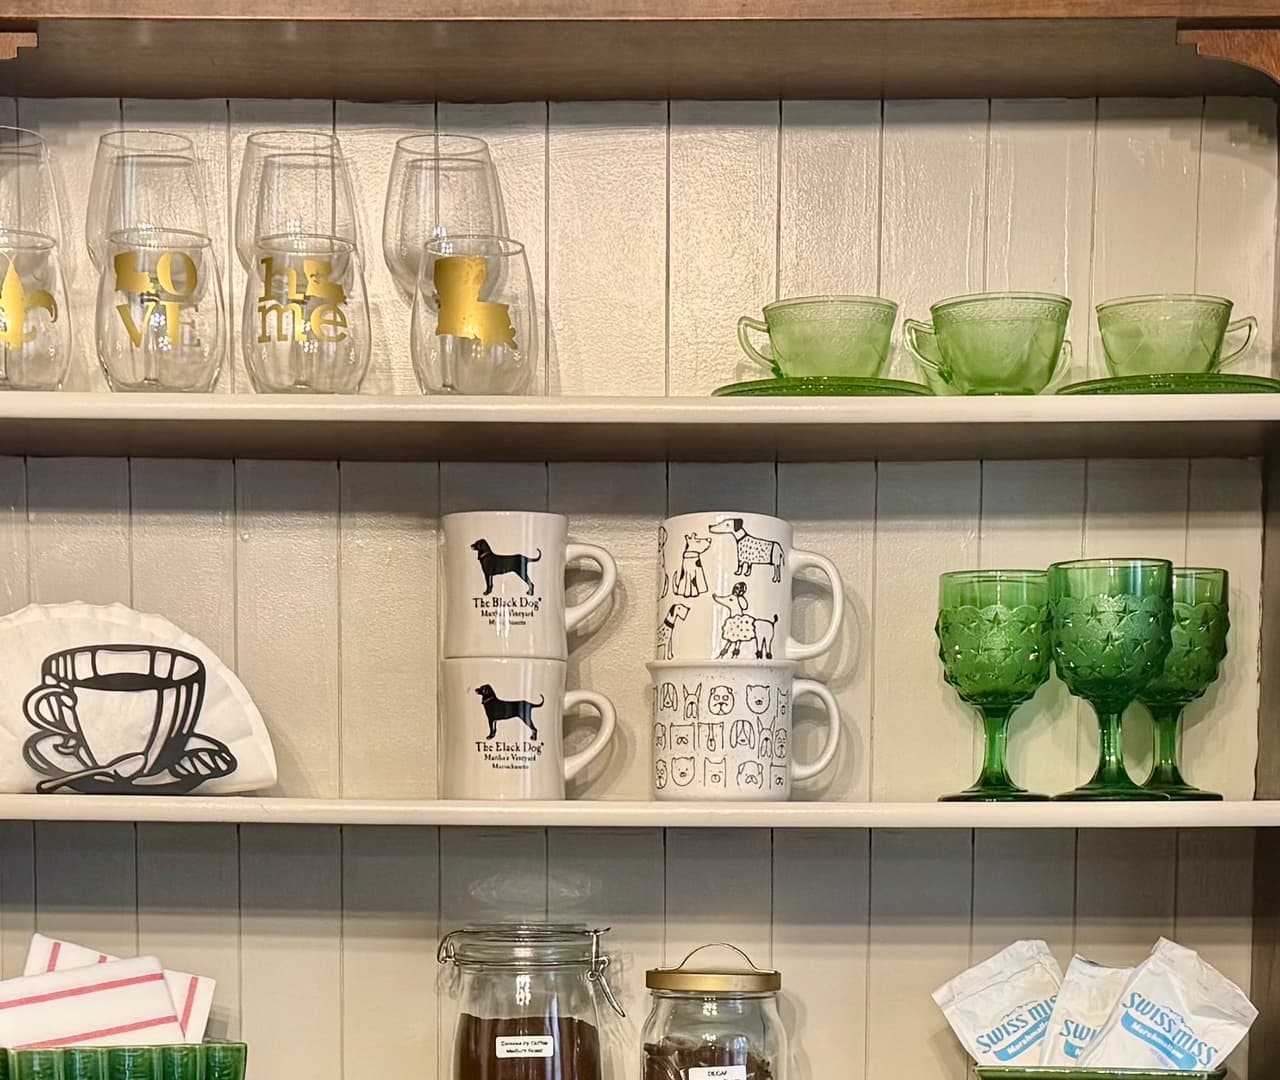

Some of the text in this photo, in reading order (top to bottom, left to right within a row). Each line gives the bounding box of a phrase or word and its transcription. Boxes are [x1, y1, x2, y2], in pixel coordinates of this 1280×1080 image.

[472, 597, 539, 611] The Black Dog
[475, 741, 542, 755] The Black Dog
